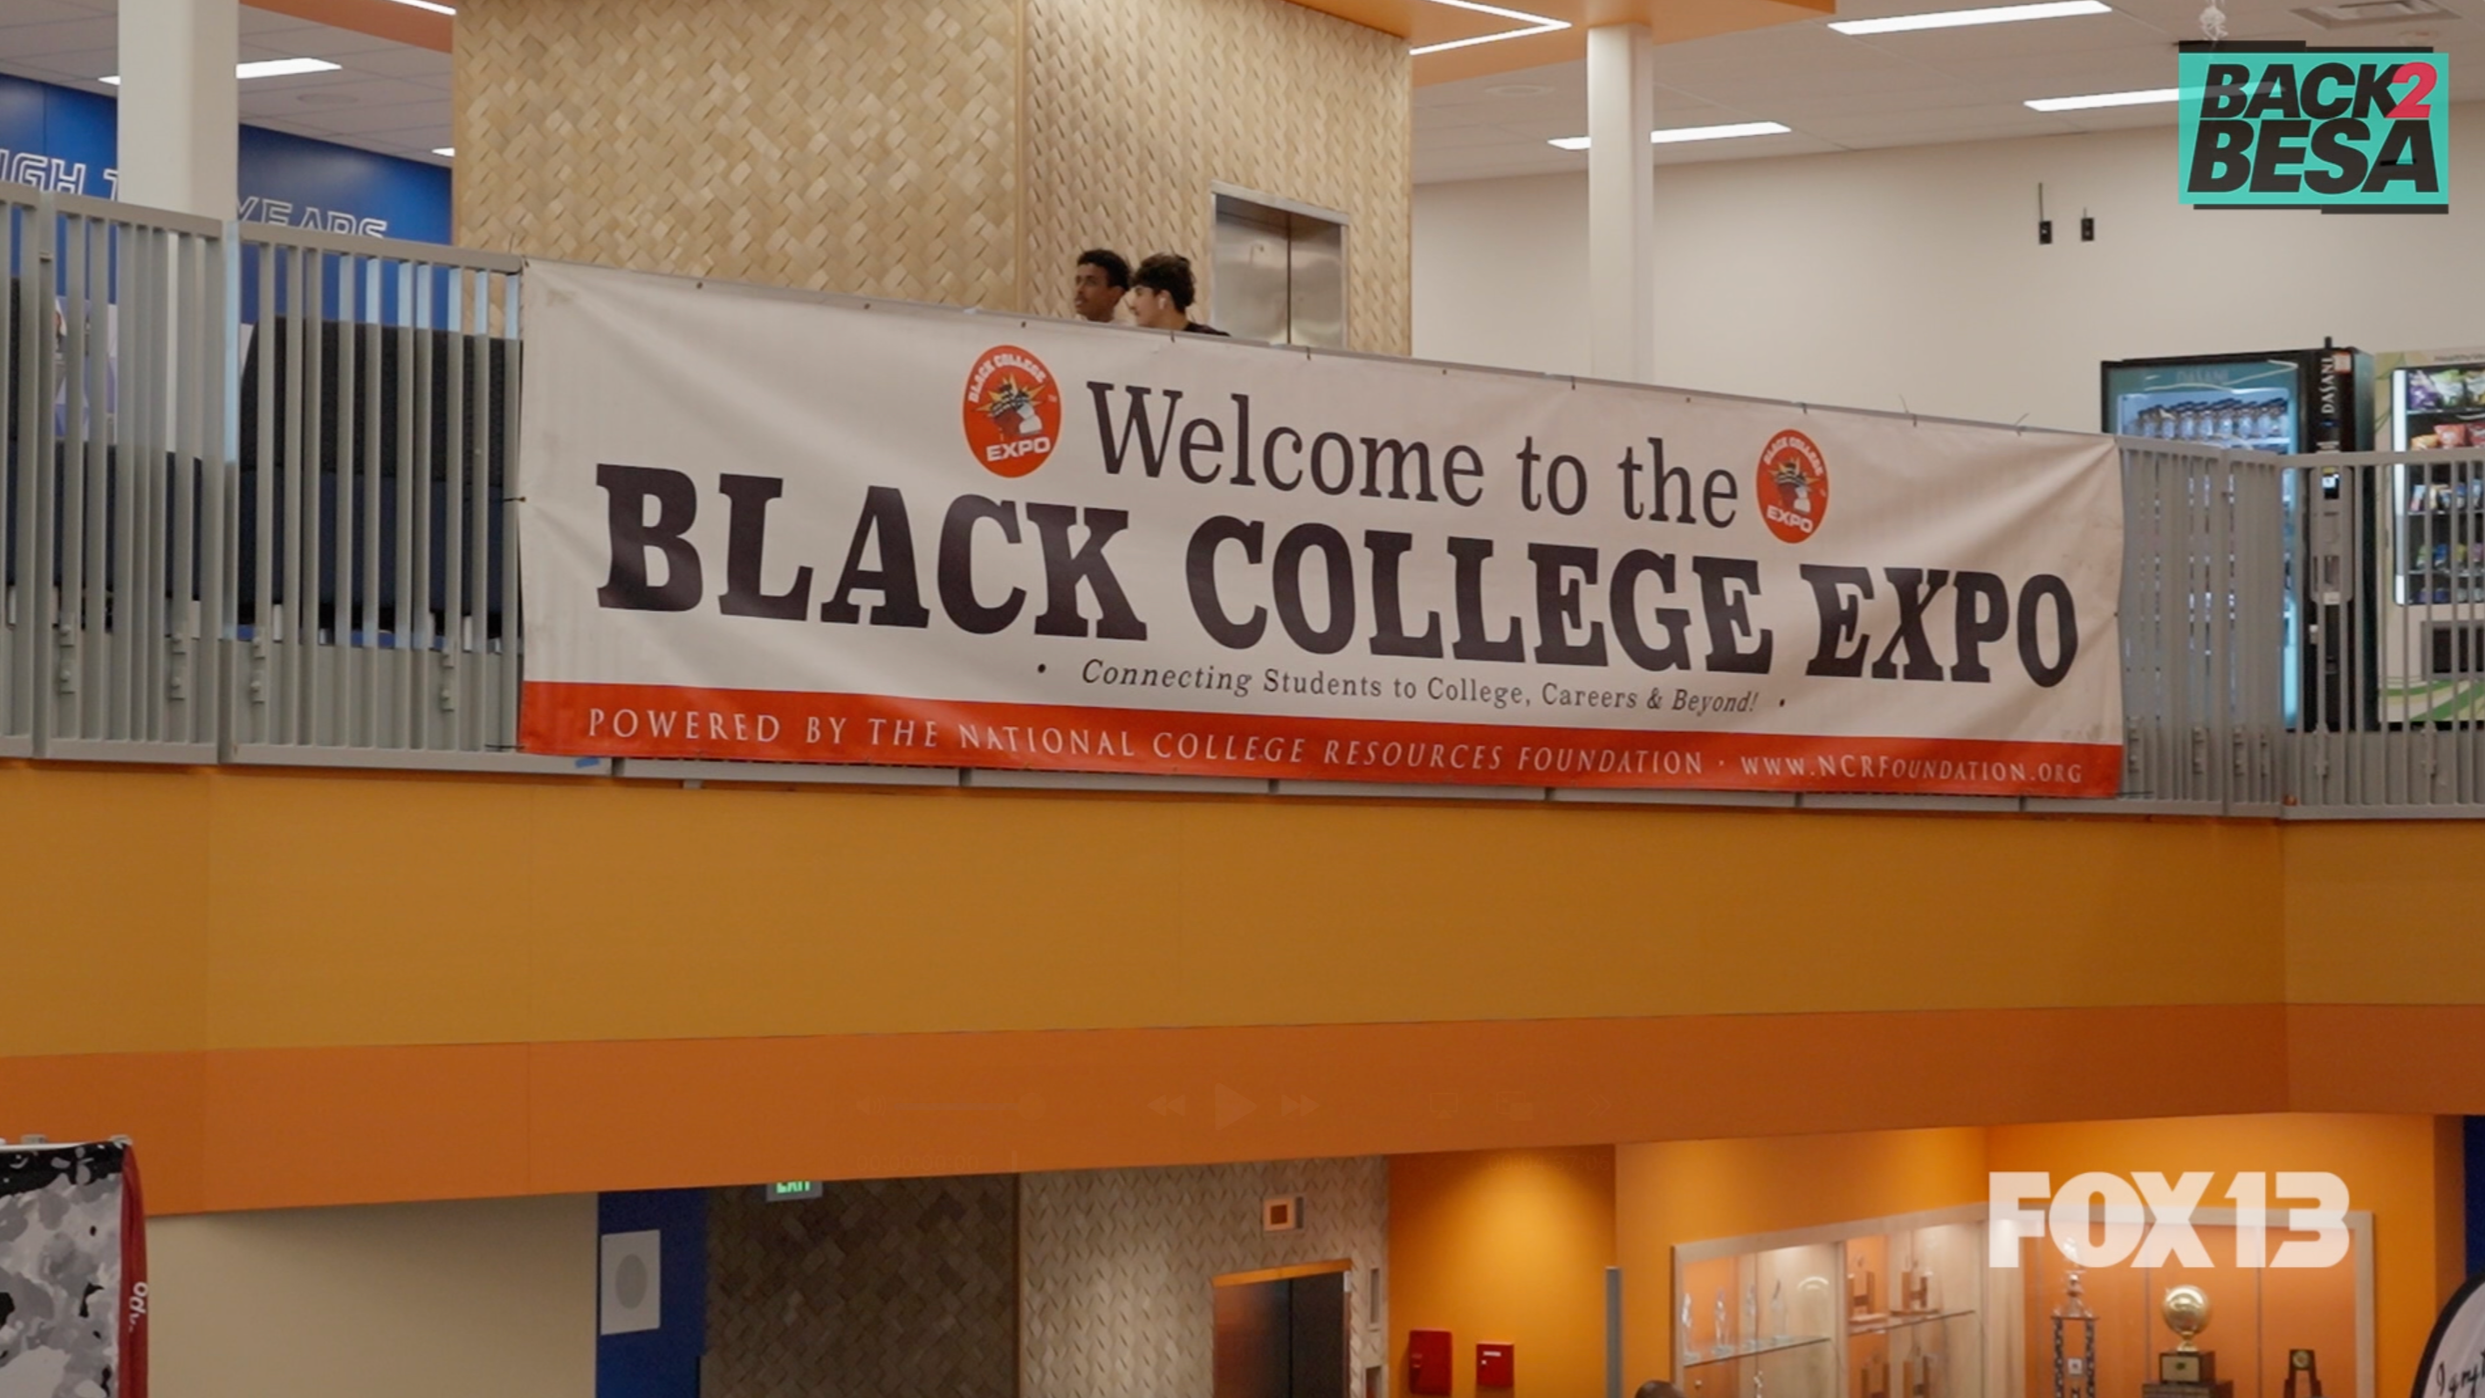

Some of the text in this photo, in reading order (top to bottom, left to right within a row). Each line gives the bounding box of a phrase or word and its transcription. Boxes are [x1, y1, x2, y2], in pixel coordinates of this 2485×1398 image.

[2319, 356, 2337, 415] DASANI
[986, 436, 1051, 462] EXPO
[1086, 381, 1738, 528] Welcome to the
[1766, 504, 1814, 533] EXPO
[596, 463, 2078, 687] BLACK COLLEGE EXPO
[1081, 658, 1760, 717] Connecting Students to College, Careers & Beyond!
[588, 708, 781, 742] POWERED
[806, 715, 847, 743] BY
[867, 717, 938, 747] THE
[958, 723, 1135, 757] NATIONAL
[1153, 732, 1305, 762] COLLEGE
[1323, 739, 1503, 770] RESOURCES
[1517, 746, 1702, 775] FOUNDATION
